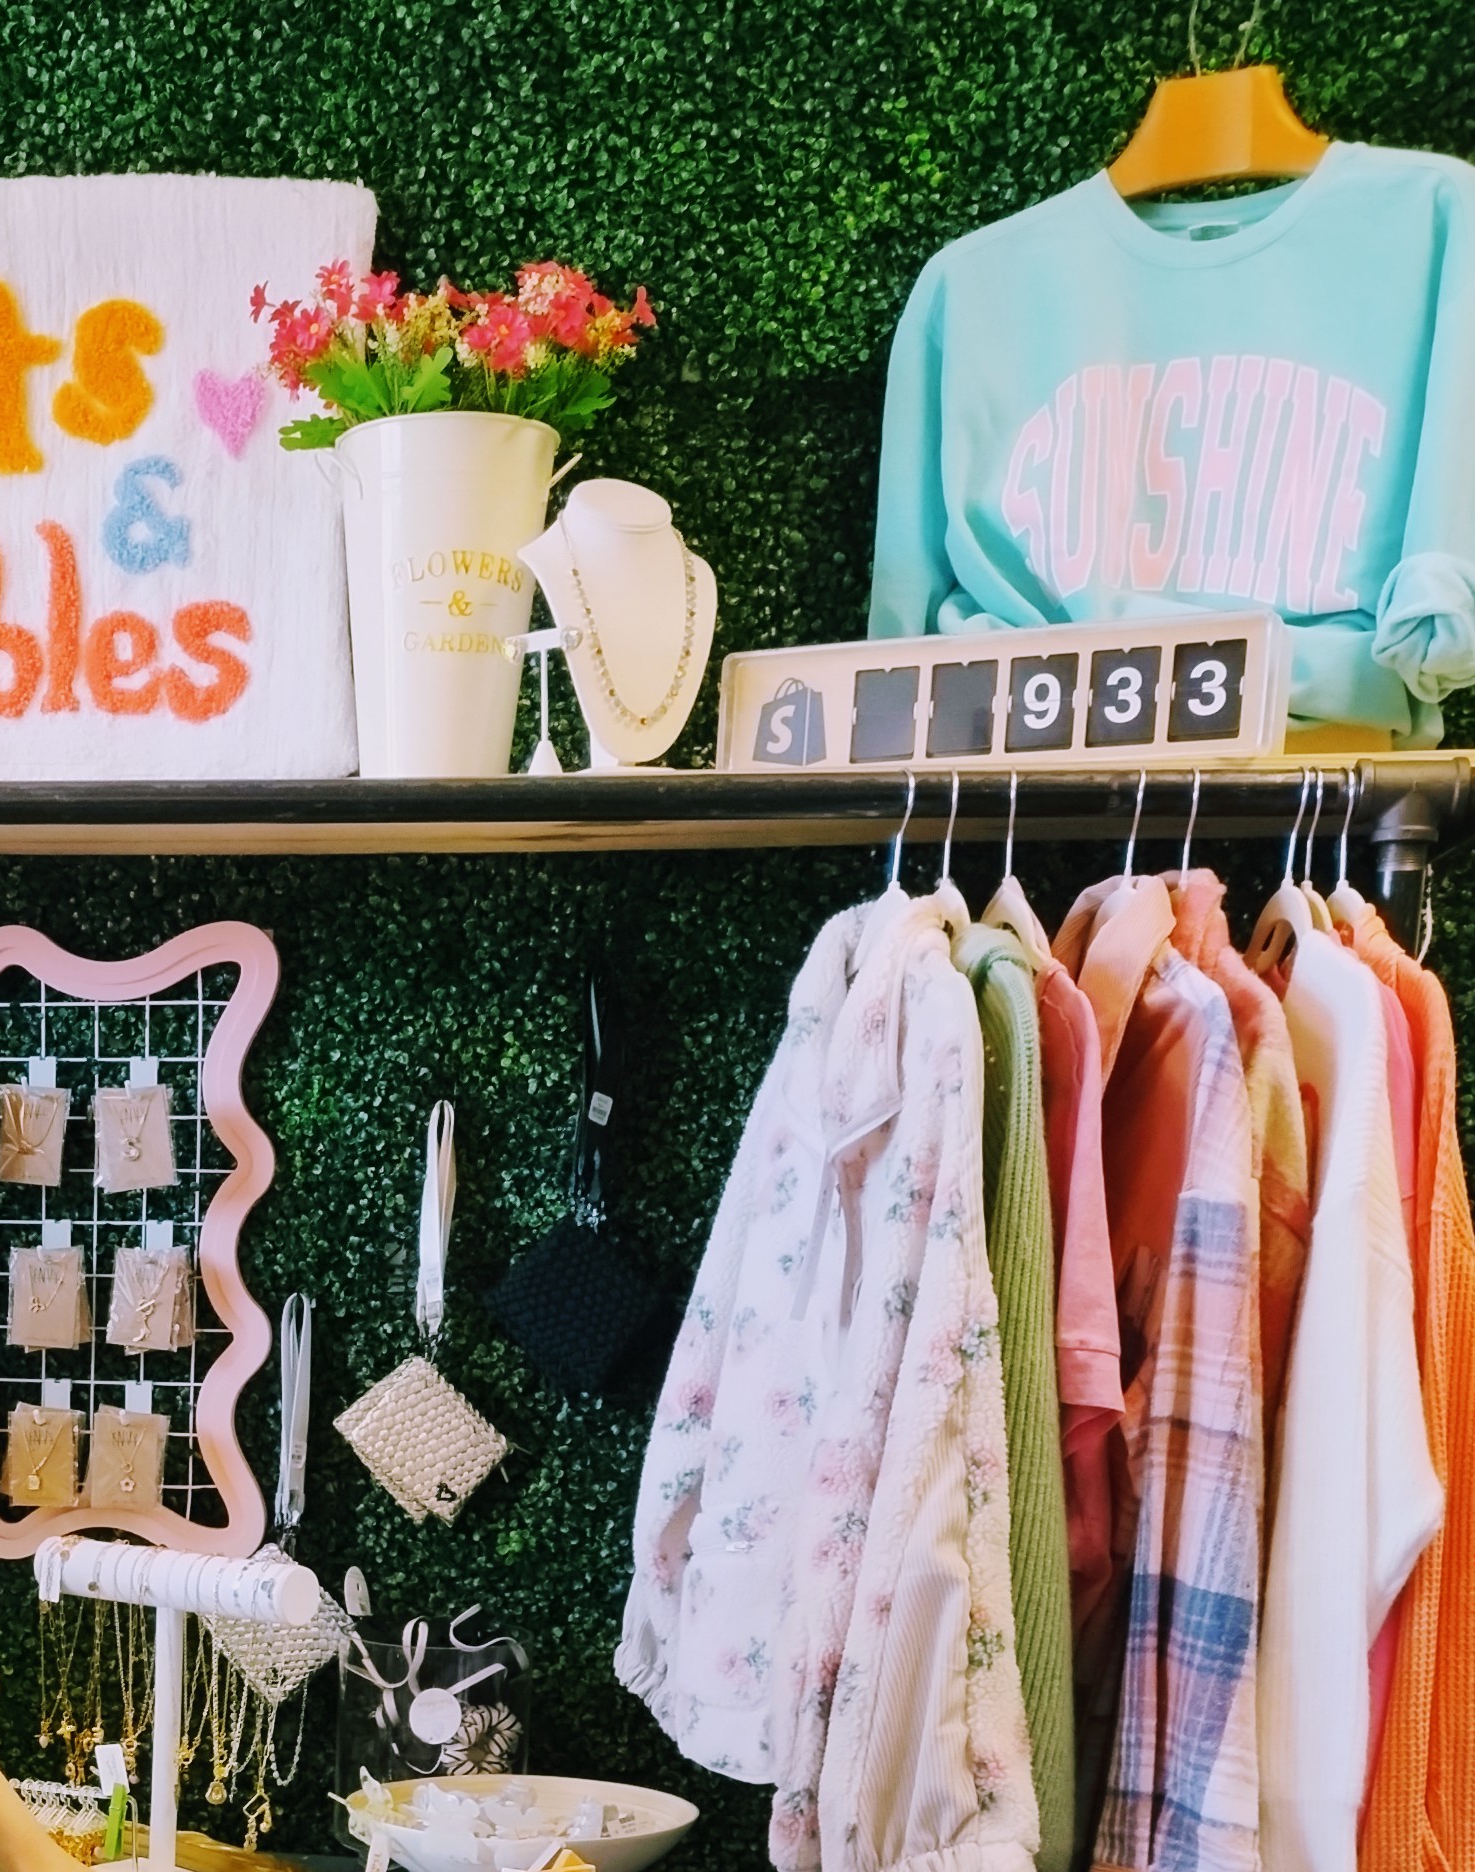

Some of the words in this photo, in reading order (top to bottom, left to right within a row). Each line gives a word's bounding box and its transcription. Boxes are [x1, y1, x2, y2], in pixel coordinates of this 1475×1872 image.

[103, 454, 189, 574] &
[391, 549, 524, 594] FLOWERS
[448, 590, 474, 617] &
[766, 704, 796, 754] S
